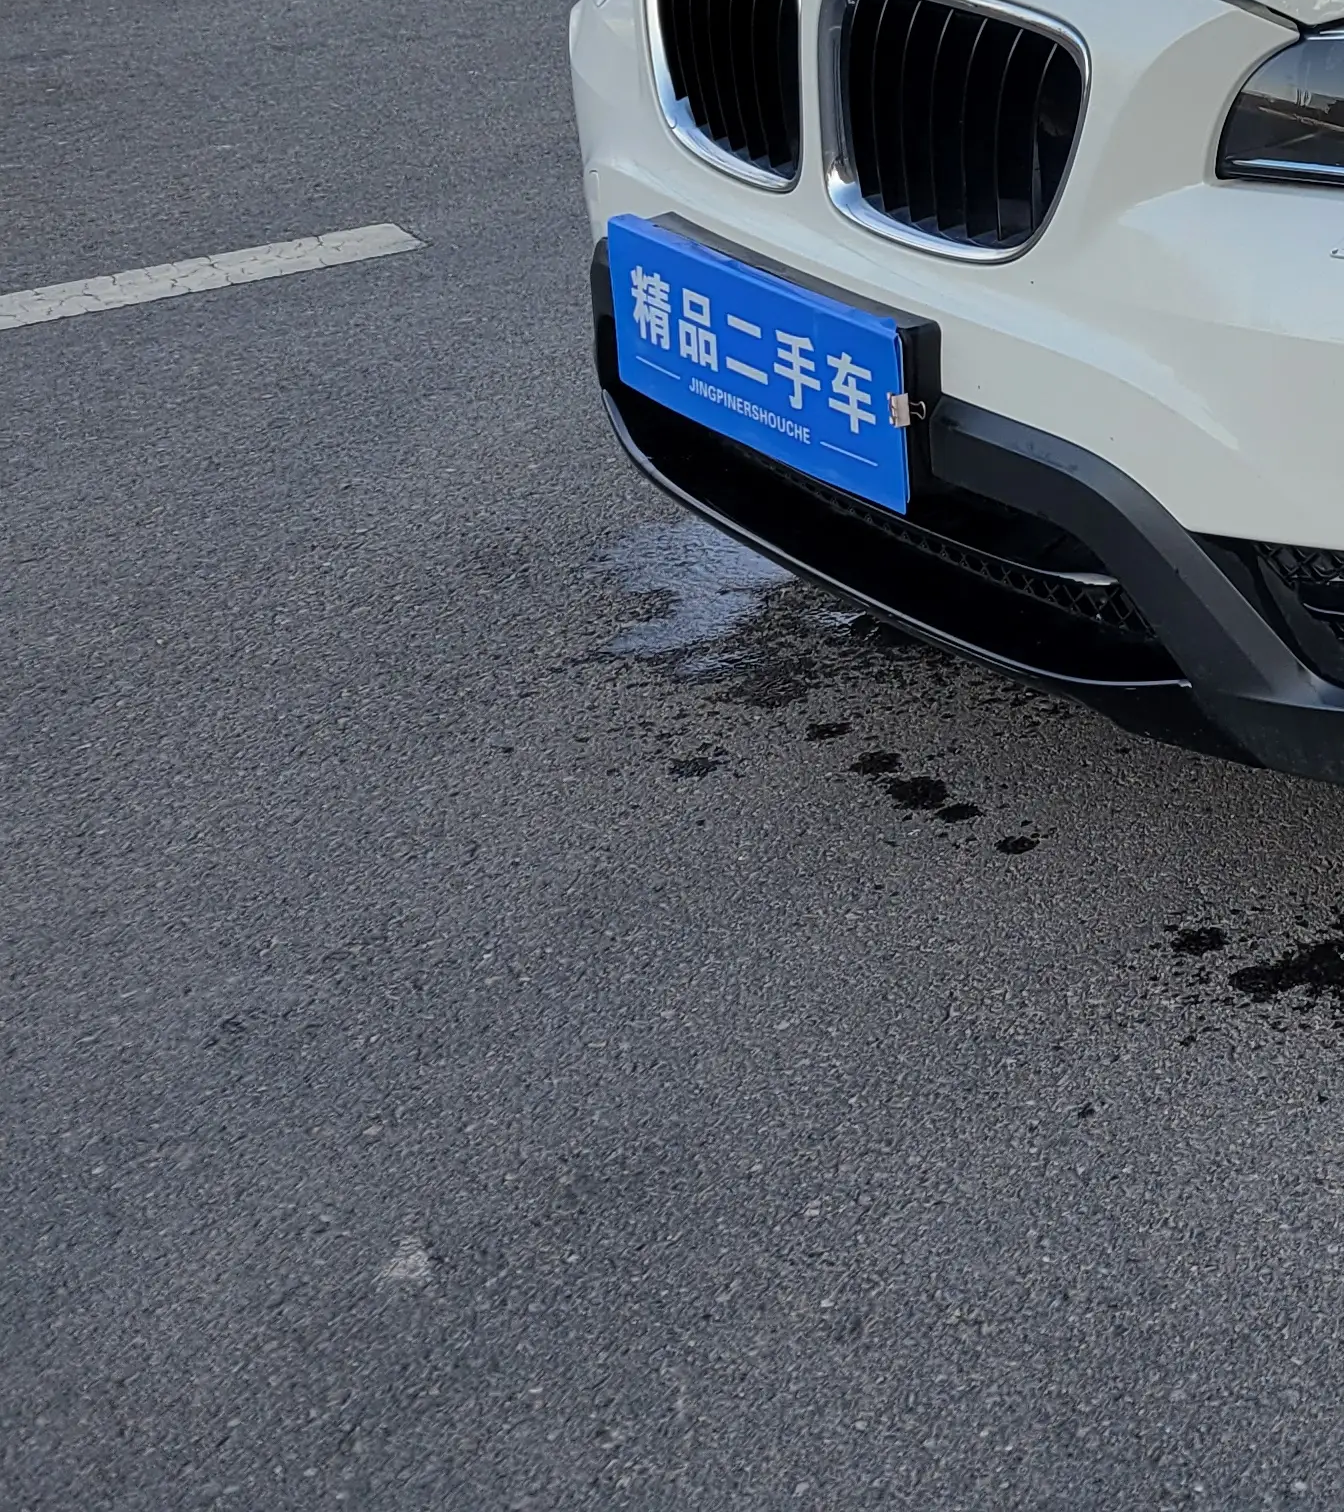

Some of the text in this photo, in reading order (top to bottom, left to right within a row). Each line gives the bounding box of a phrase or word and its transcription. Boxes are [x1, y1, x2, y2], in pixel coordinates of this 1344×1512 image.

[630, 265, 877, 435] 精品二手车
[688, 377, 811, 445] JINGPINERSHOUCHE
